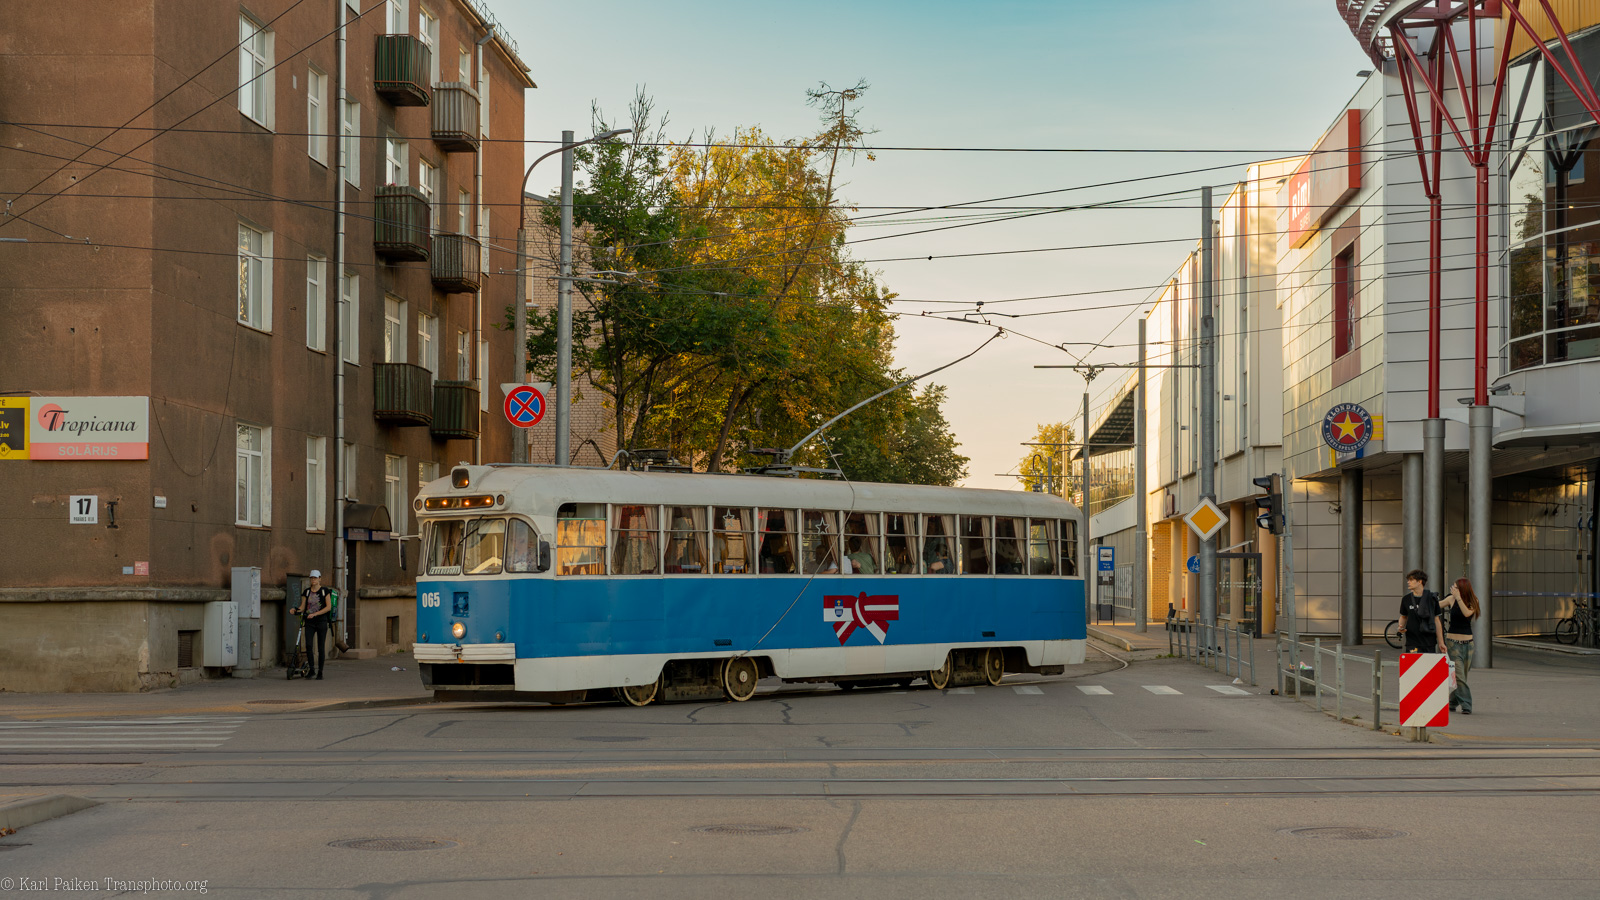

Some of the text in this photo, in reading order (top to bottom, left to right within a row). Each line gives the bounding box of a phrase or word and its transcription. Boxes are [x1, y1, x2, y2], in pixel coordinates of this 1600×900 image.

[1326, 404, 1370, 422] KLONDAIKA
[43, 409, 139, 437] Tropicana
[58, 444, 118, 456] SOLĀRIJS
[76, 498, 92, 515] 17
[421, 592, 441, 608] 065
